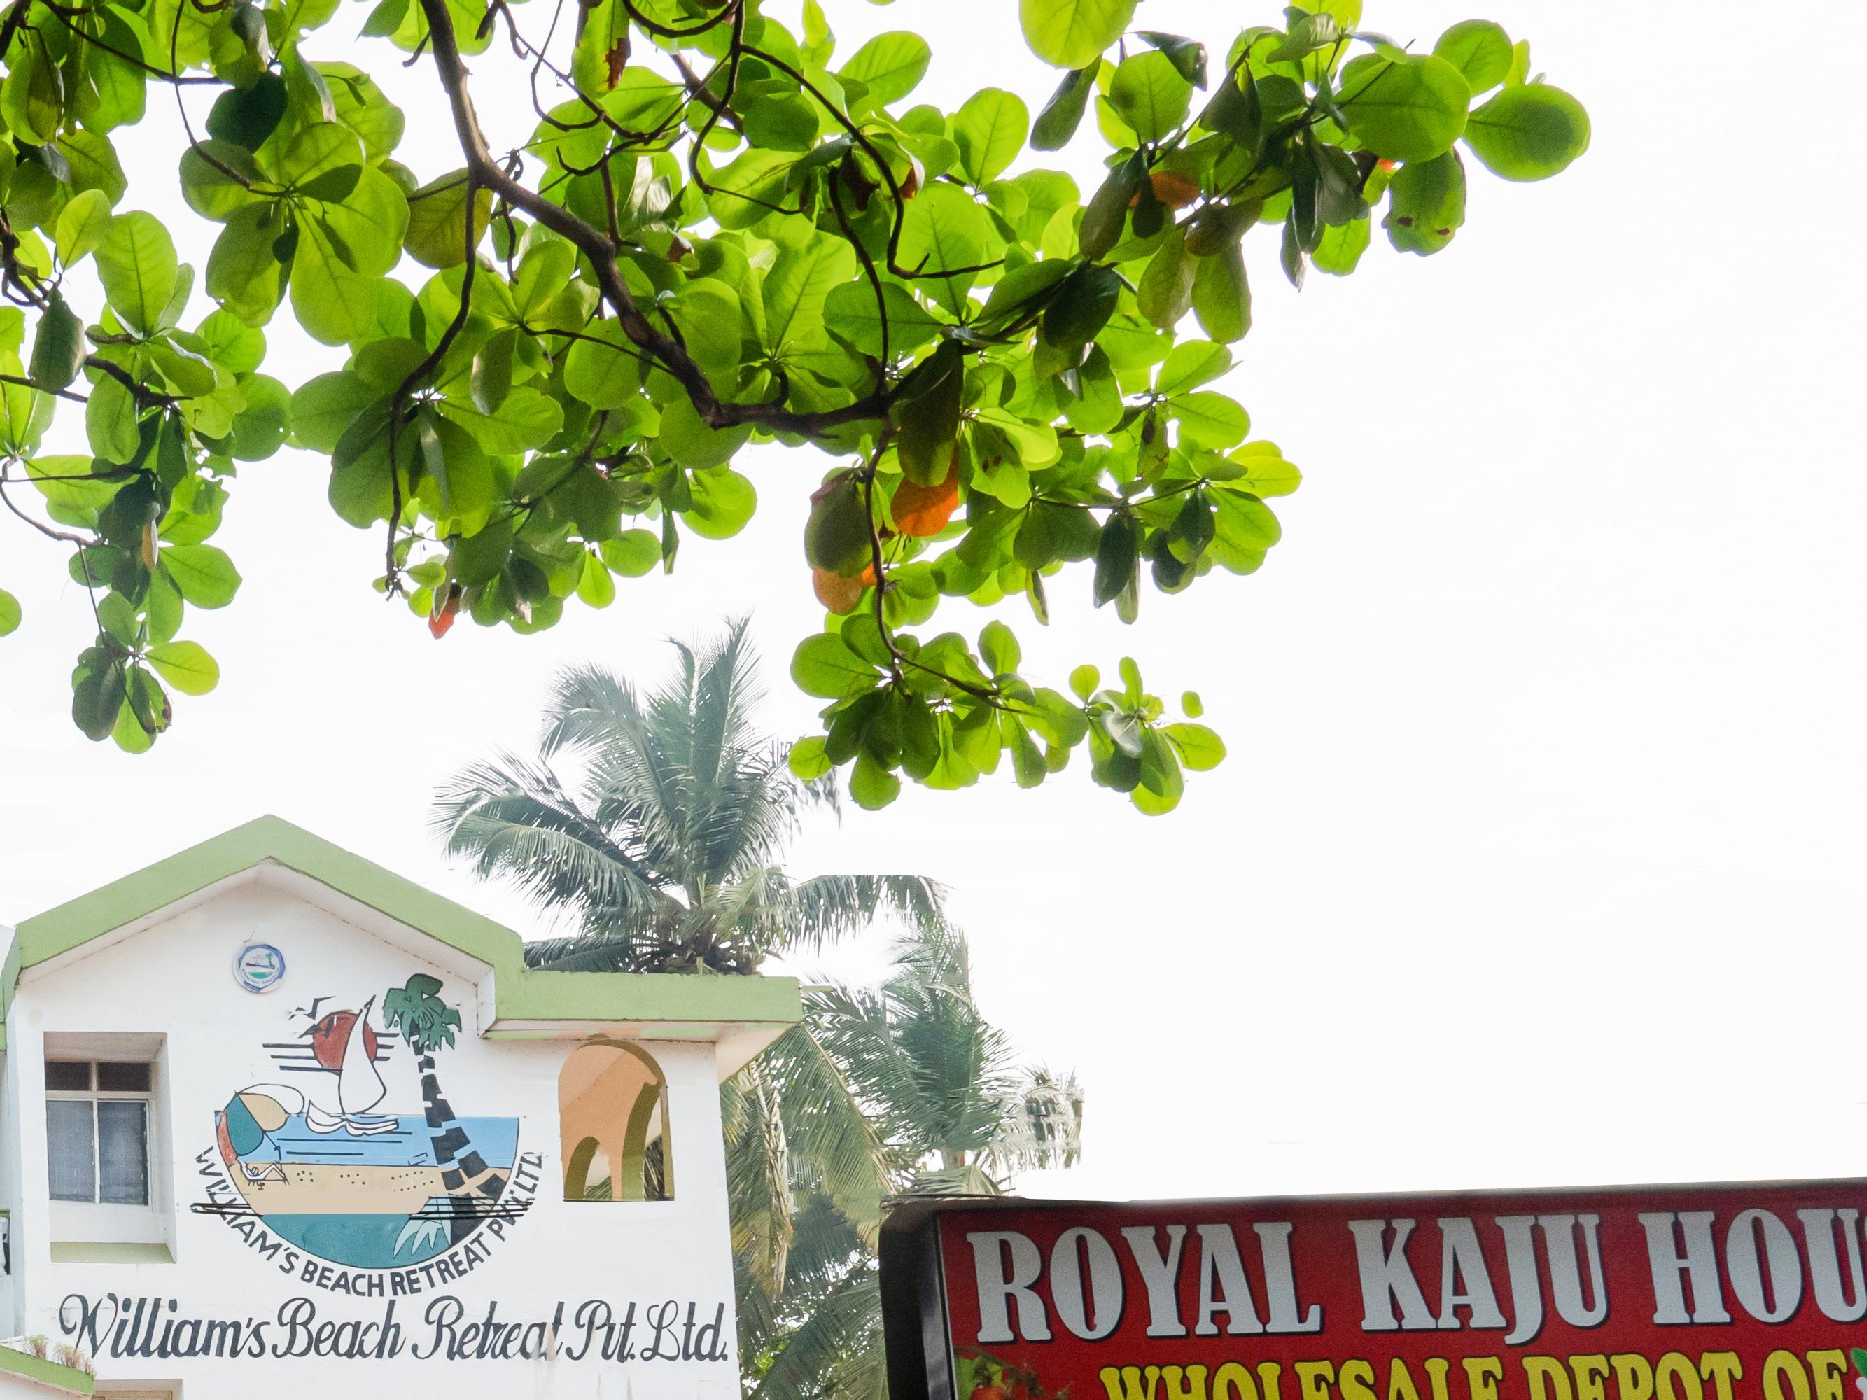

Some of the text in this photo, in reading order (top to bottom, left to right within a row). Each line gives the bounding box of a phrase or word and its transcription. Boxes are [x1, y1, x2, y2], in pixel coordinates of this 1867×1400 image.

[300, 1260, 384, 1298] BEACH
[390, 1230, 493, 1297] RETREAT
[966, 1207, 1867, 1346] ROYAL KAJU HOU
[59, 1292, 270, 1361] William's
[270, 1297, 407, 1361] Beach
[411, 1295, 564, 1362] Retreat
[639, 1299, 729, 1362] Ltd.
